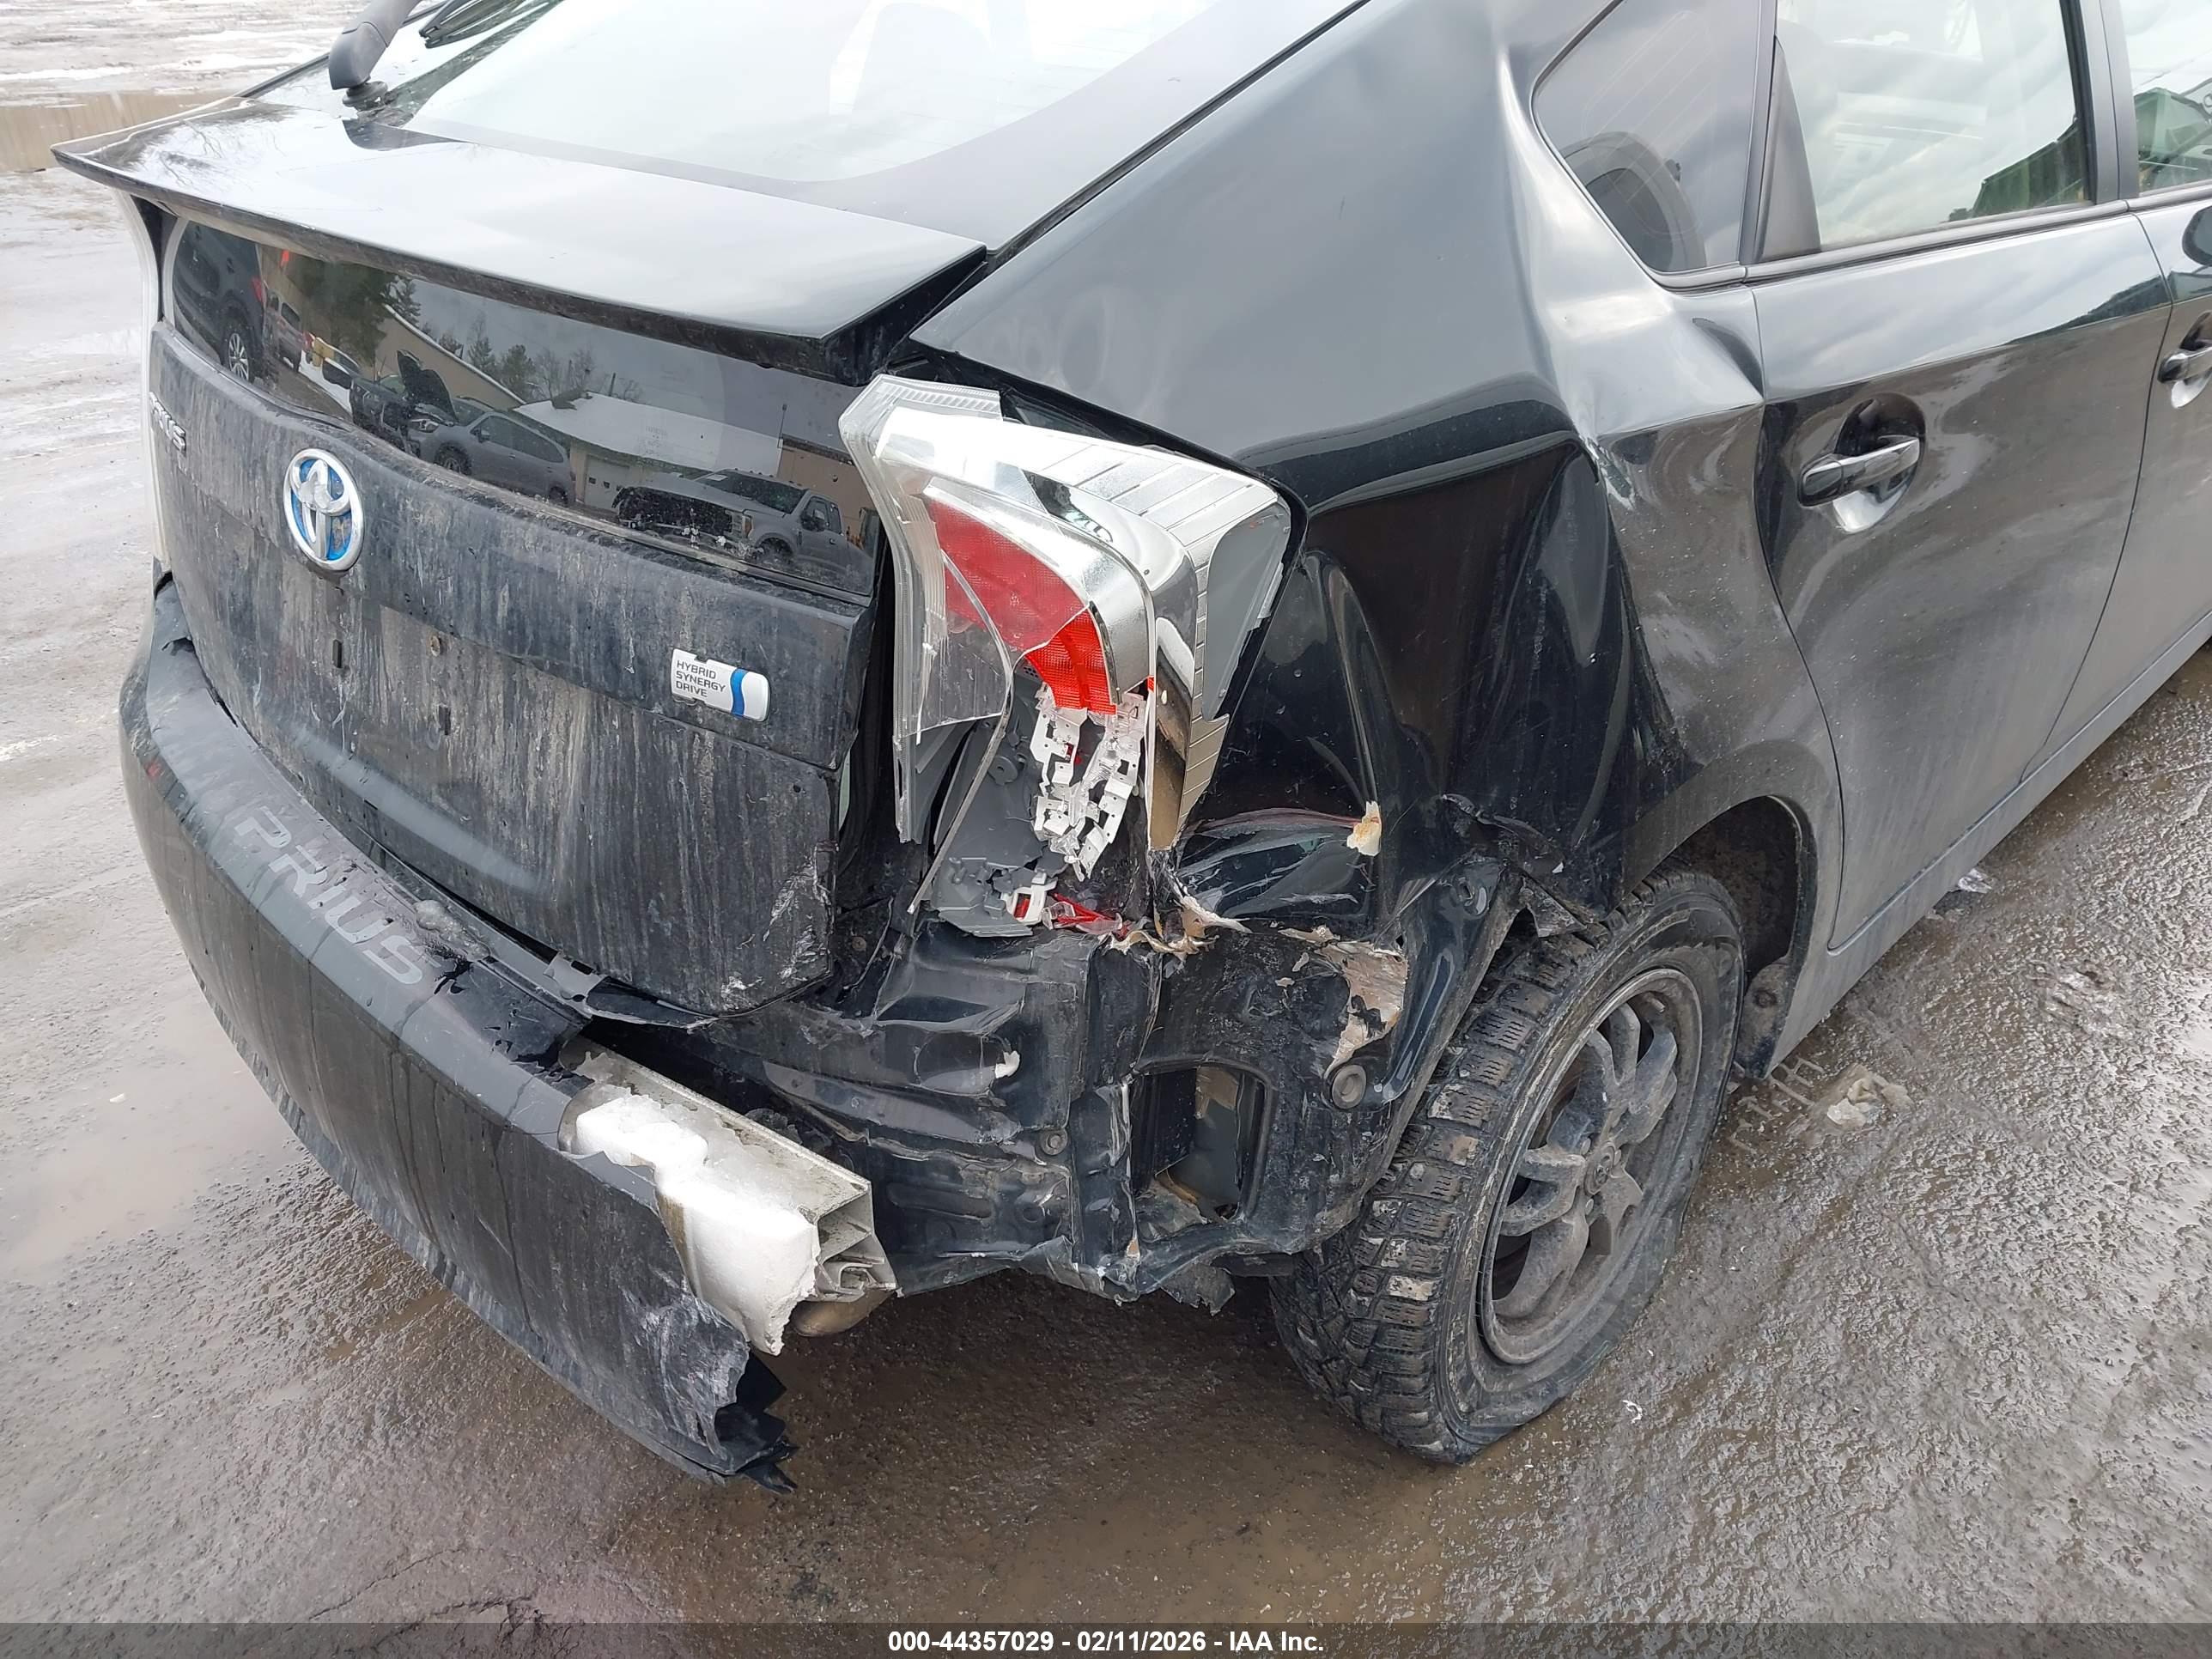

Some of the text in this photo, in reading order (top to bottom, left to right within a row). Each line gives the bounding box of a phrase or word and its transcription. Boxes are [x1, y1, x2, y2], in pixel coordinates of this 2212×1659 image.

[677, 659, 716, 679] HYBRID
[676, 671, 726, 692] SYNERGY
[676, 680, 707, 697] DRIVE
[234, 805, 441, 985] PRIUS
